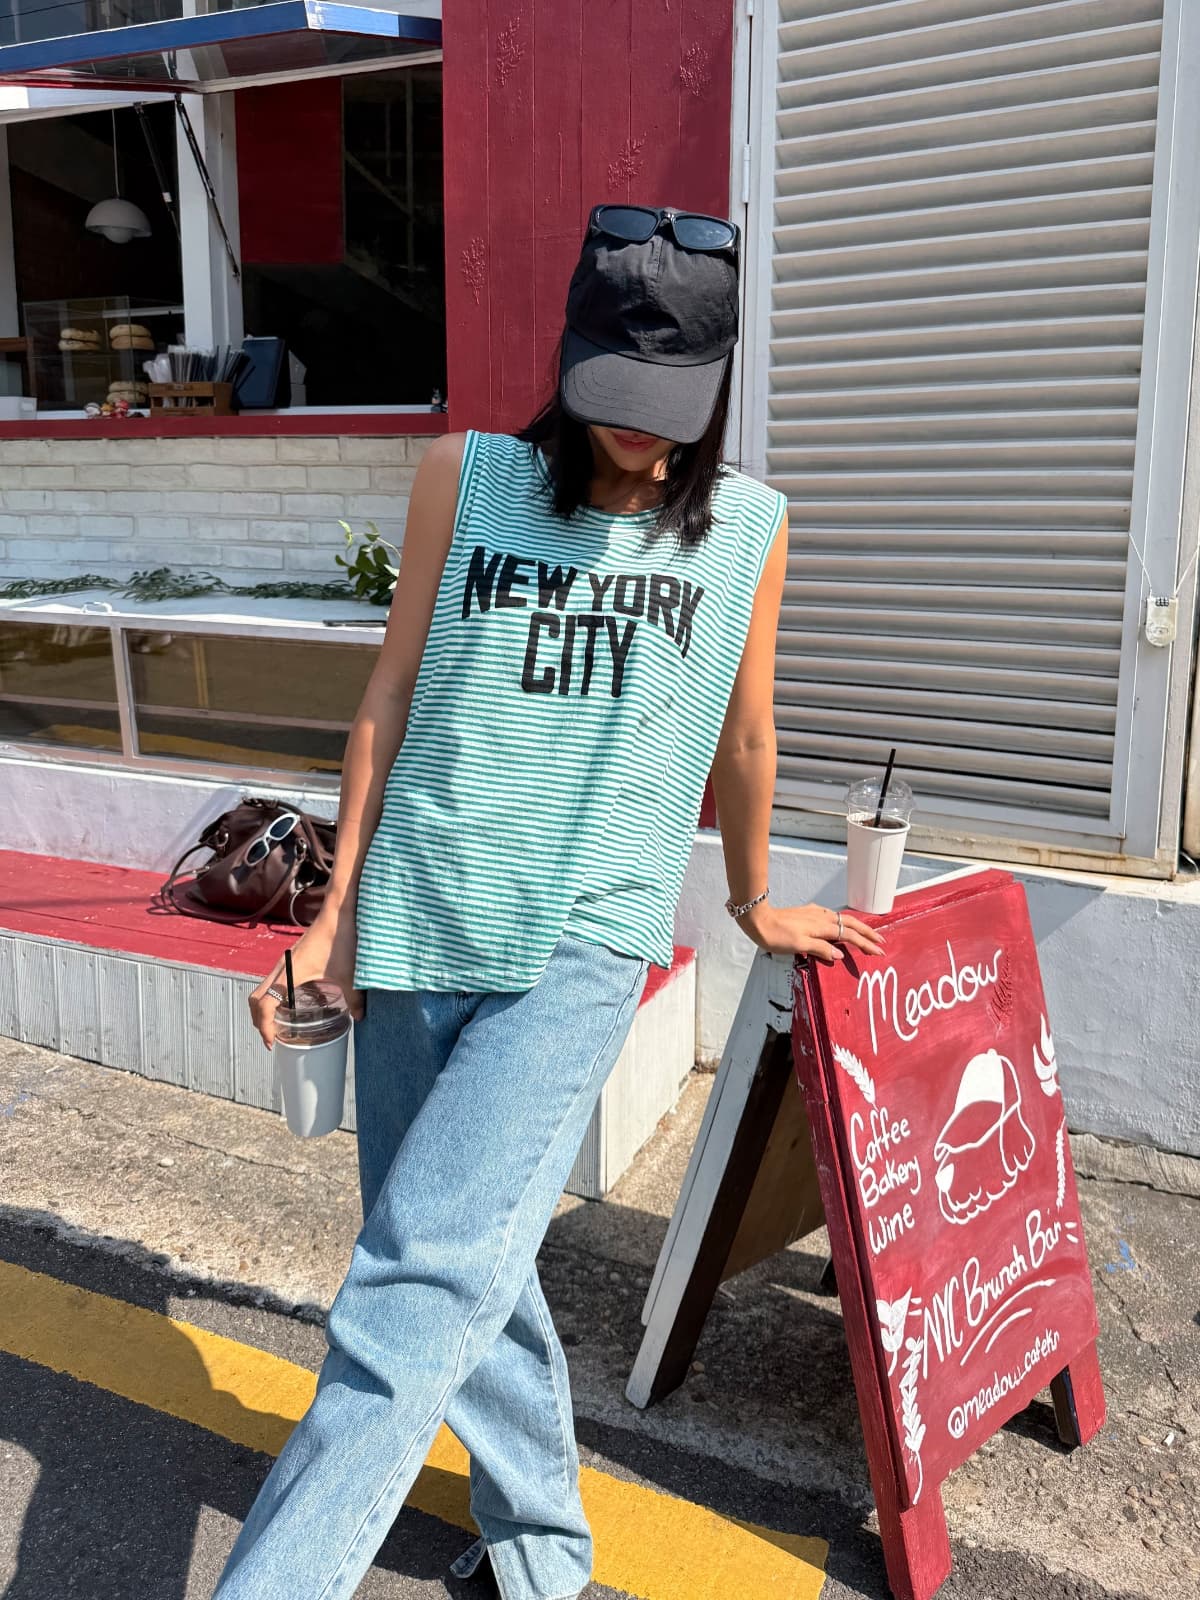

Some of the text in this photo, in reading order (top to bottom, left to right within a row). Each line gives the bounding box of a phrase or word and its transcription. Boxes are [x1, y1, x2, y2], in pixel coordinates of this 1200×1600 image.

[462, 546, 705, 658] NEW YORK
[521, 612, 638, 698] CITY
[857, 939, 1002, 1055] Meadow
[850, 1108, 911, 1169] Coffee
[858, 1156, 921, 1207] Bakery
[869, 1203, 915, 1254] Wine
[923, 1209, 1061, 1379] NYC Brunch Bar
